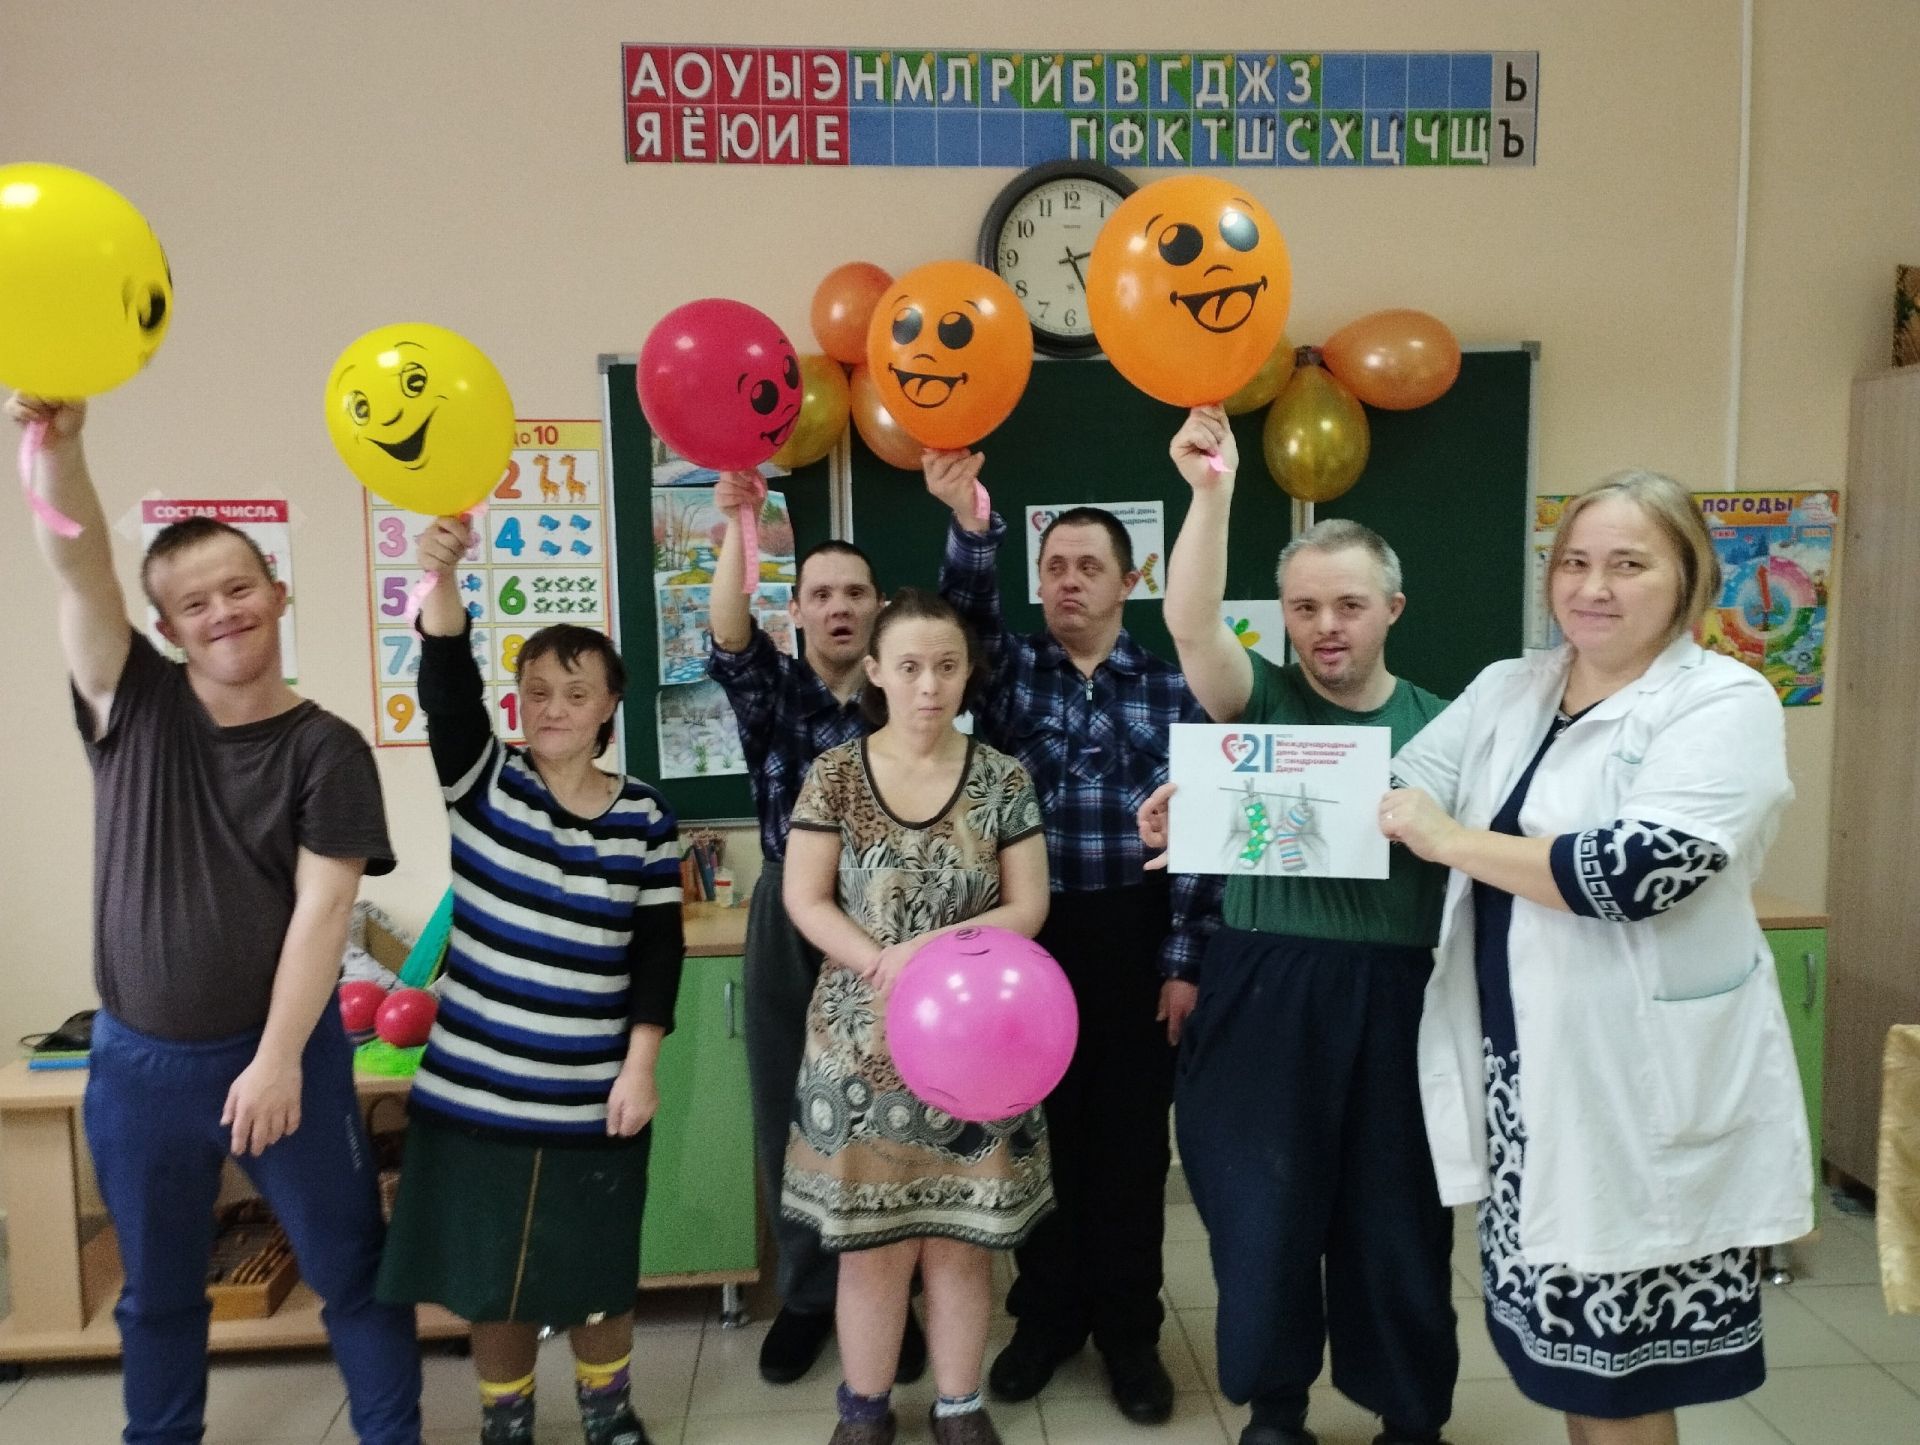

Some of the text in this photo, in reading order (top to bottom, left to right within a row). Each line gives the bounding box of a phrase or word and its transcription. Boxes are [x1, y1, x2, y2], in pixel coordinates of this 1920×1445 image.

[1039, 199, 1052, 217] 11
[1063, 191, 1081, 210] 12
[1099, 201, 1105, 218] 1
[1017, 219, 1034, 238] 10
[1006, 249, 1019, 268] 9
[1015, 279, 1028, 298] 8
[1038, 301, 1050, 318] 7
[1064, 309, 1077, 327] 6
[533, 425, 559, 445] 10
[495, 459, 522, 499] 2
[154, 506, 278, 519] СОСТАВ ЧИСЛА
[378, 517, 408, 558] 3
[495, 517, 525, 556] 4
[381, 576, 408, 616] 5
[500, 576, 527, 615] 6
[382, 636, 413, 676] 7
[502, 634, 525, 673] 8
[386, 694, 415, 733] 9
[500, 693, 519, 731] 1
